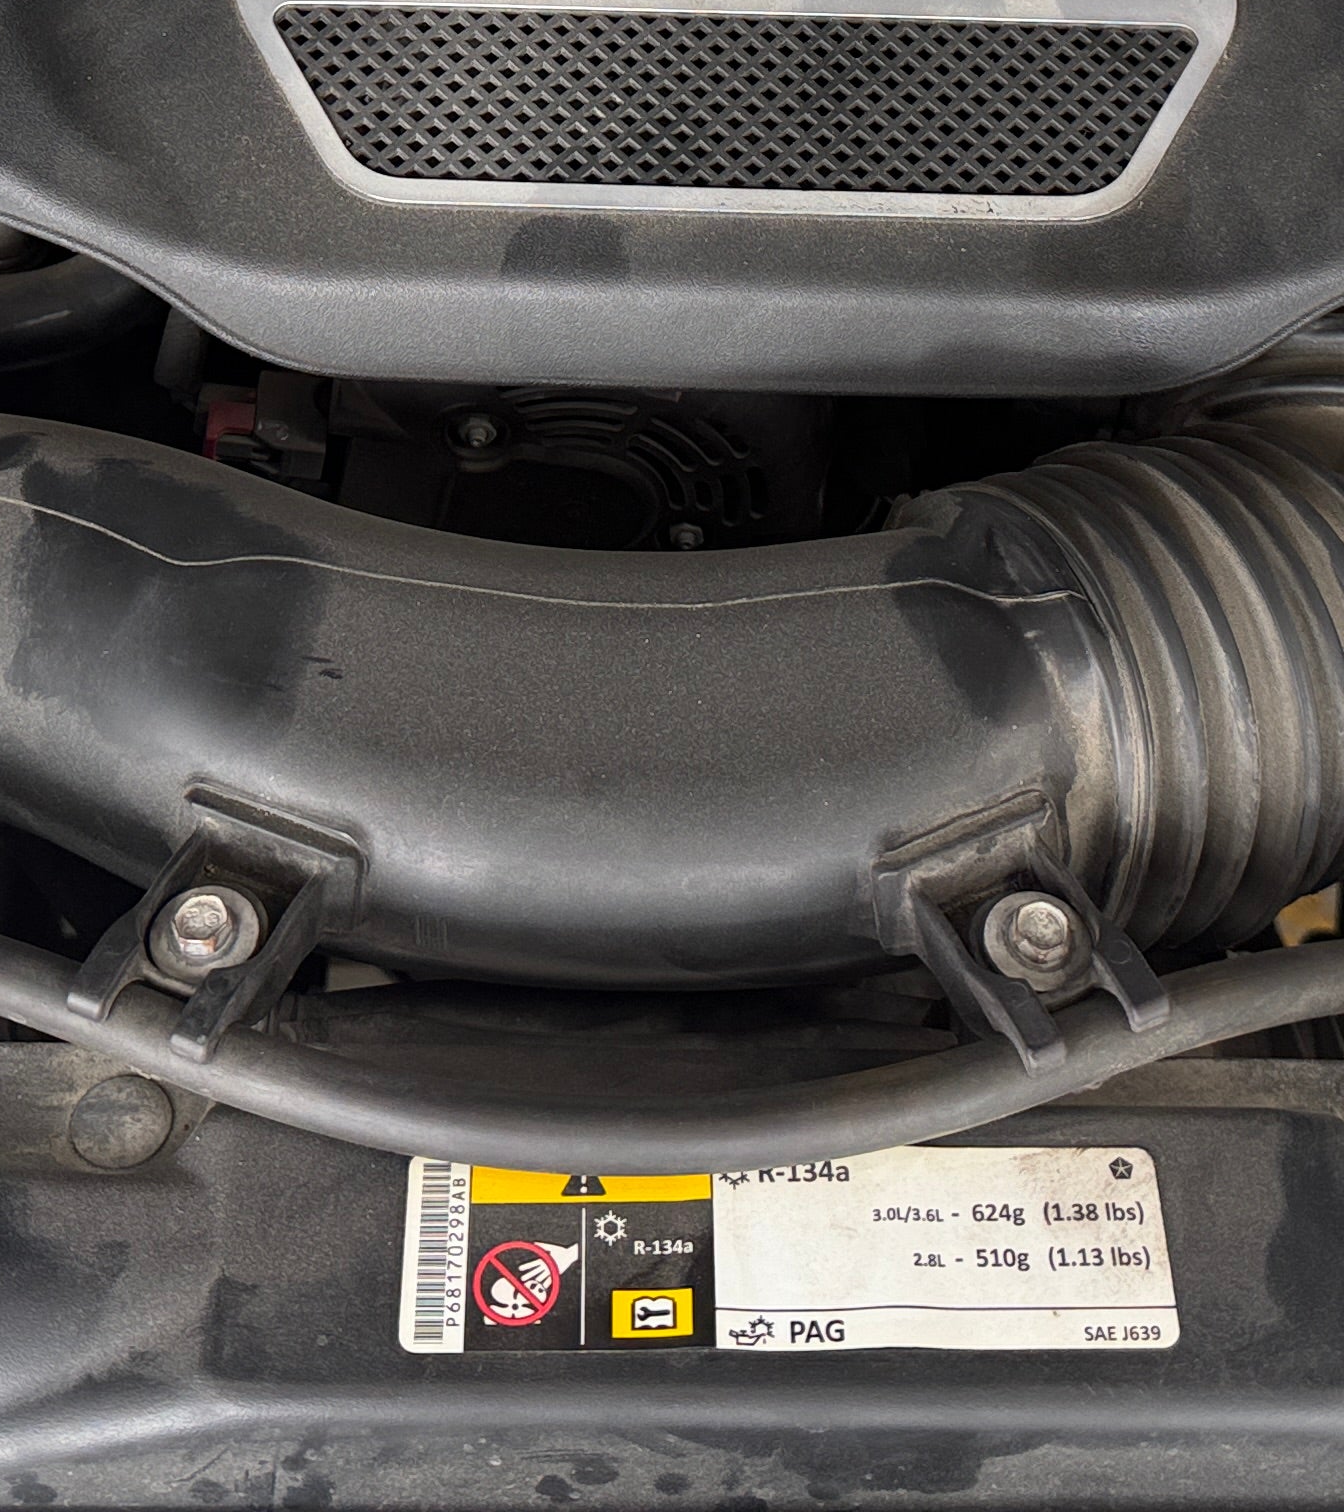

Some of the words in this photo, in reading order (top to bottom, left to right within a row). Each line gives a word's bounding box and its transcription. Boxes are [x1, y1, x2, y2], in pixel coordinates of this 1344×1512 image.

[872, 1205, 944, 1223] 3.0L/3.6L
[972, 1203, 1025, 1226] 624g
[1043, 1201, 1099, 1226] (1.38
[1106, 1201, 1145, 1225] lbs)
[445, 1177, 467, 1327] P68170298AB
[633, 1240, 694, 1255] R-134a
[913, 1252, 946, 1268] 2.8L
[976, 1248, 1030, 1272] 510g
[1048, 1246, 1105, 1271] (1.13
[1111, 1245, 1152, 1271] lbs)
[789, 1320, 845, 1344] PAG
[1084, 1325, 1116, 1341] SAE
[1122, 1325, 1162, 1342] J639
